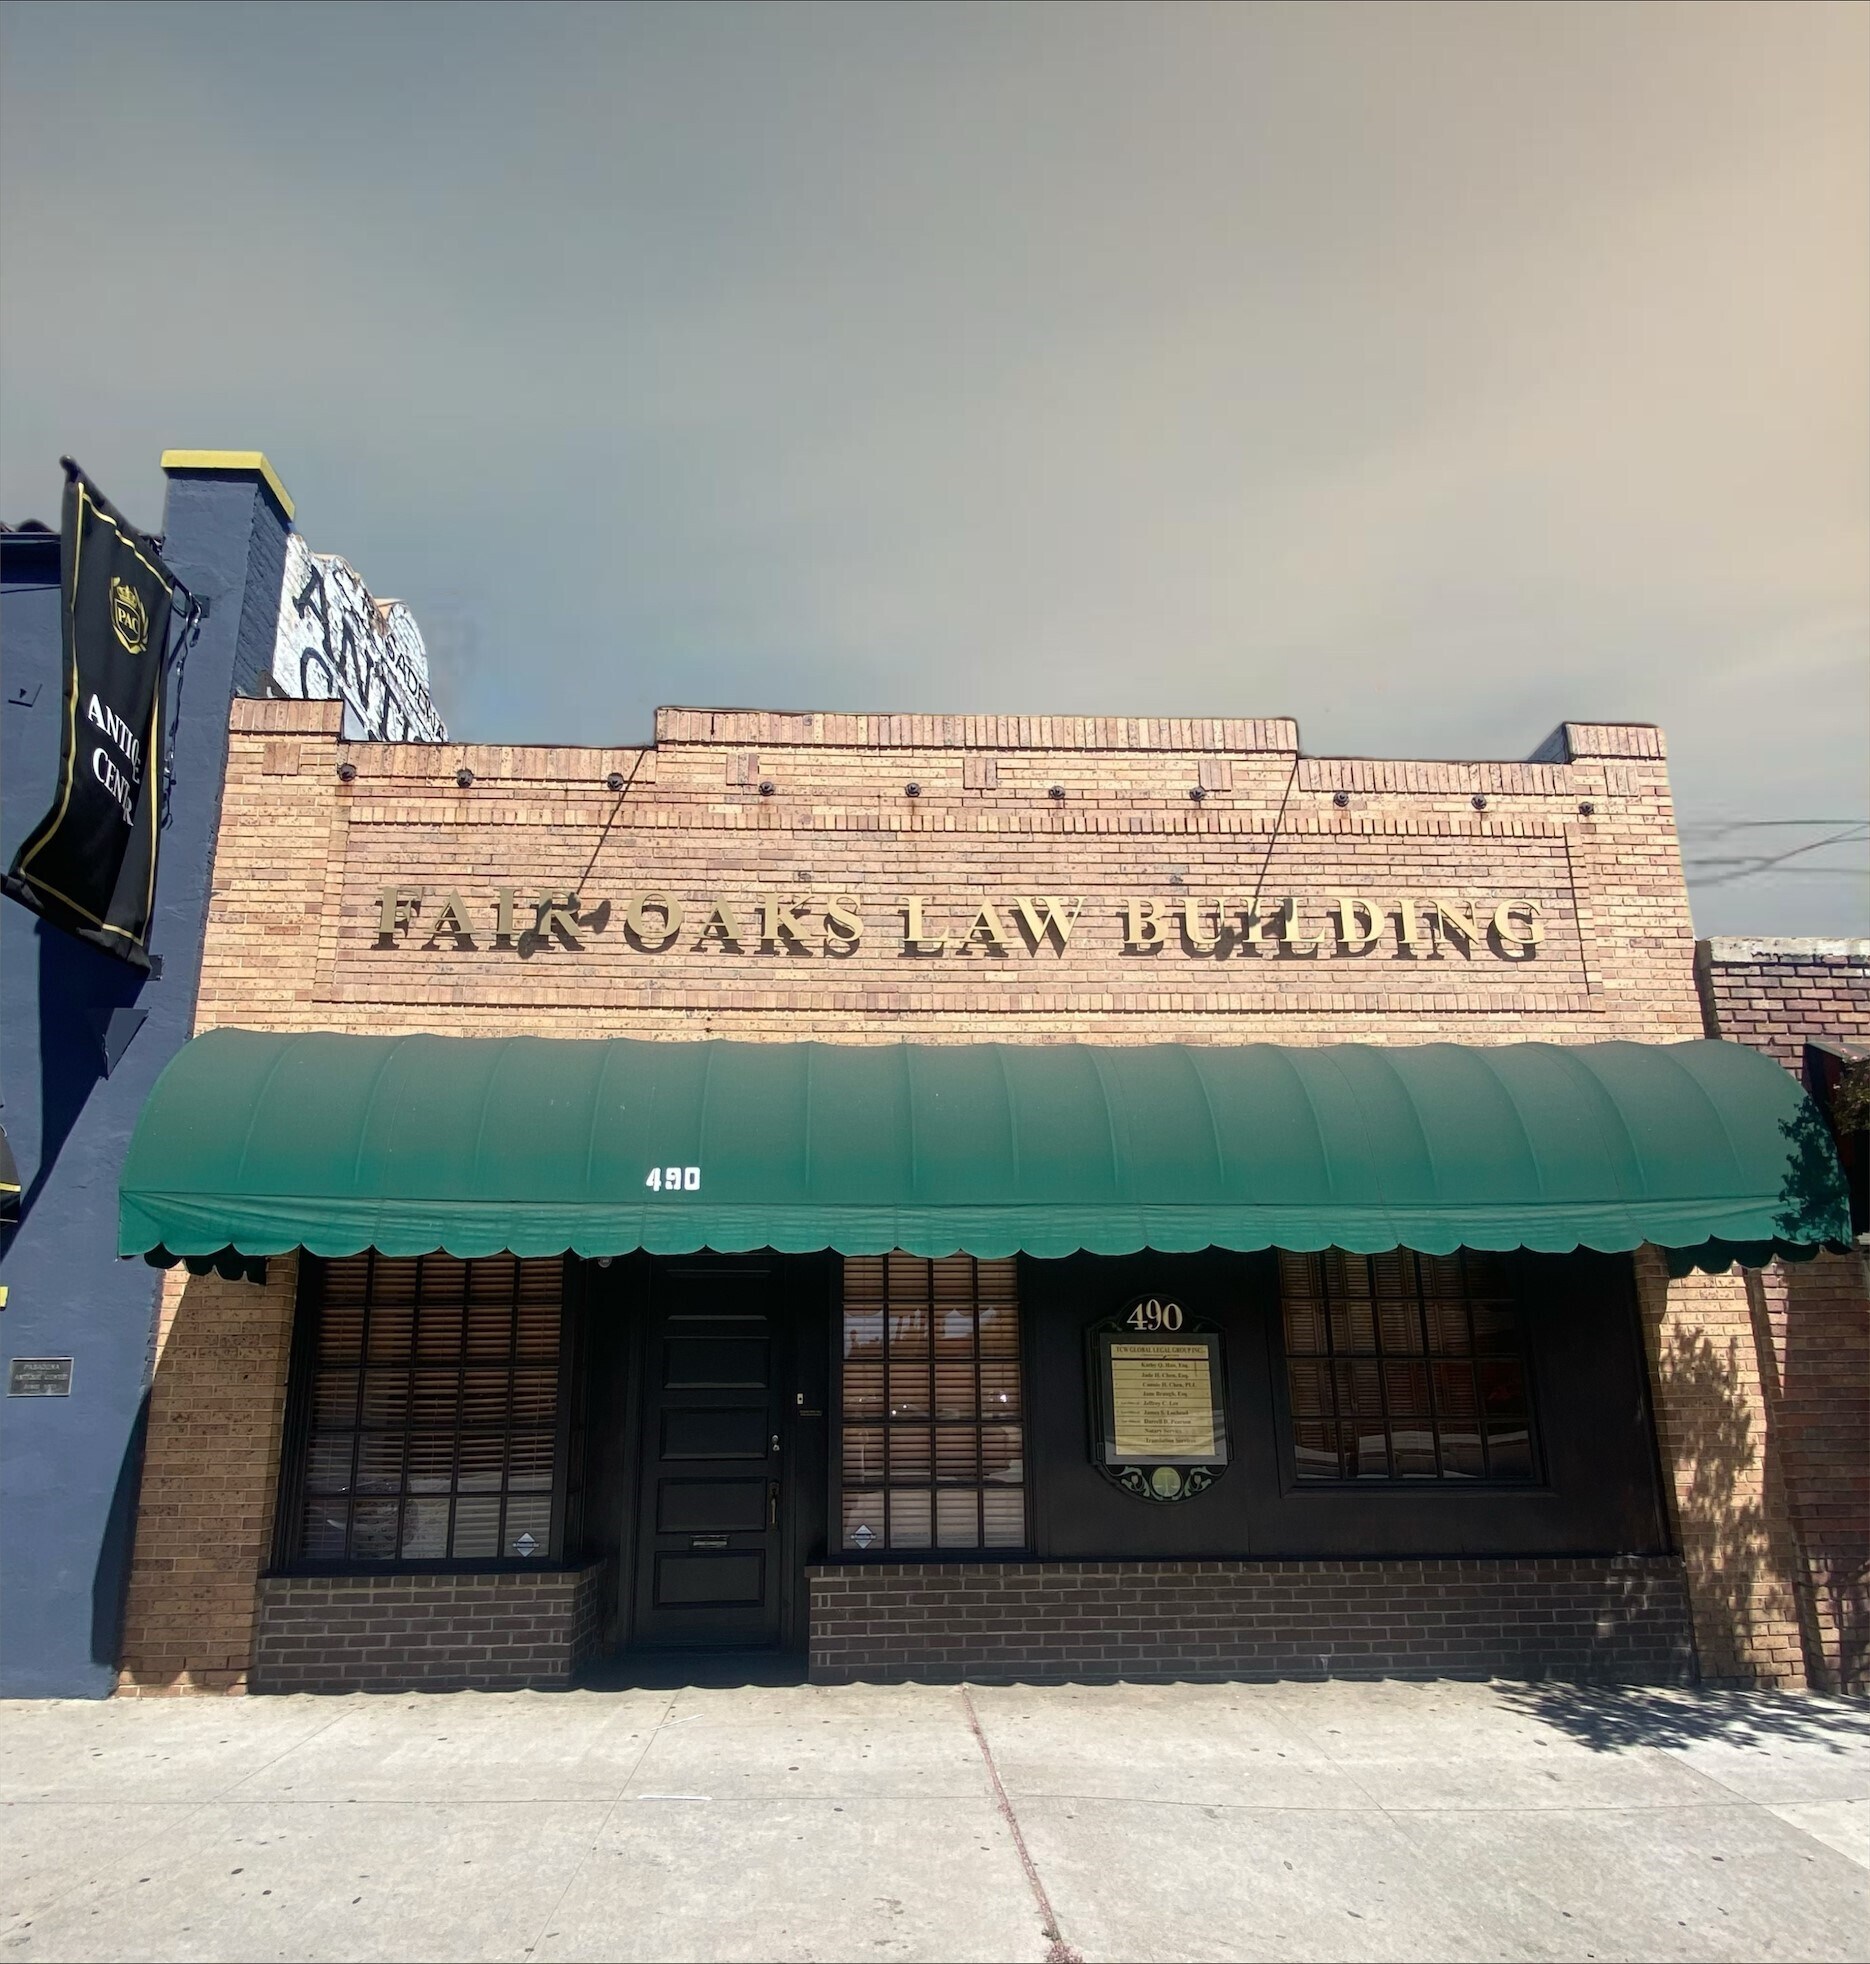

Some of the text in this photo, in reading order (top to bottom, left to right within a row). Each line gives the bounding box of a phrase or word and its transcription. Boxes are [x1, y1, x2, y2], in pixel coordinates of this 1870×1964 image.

[117, 607, 139, 634] PAC
[373, 886, 1547, 945] FAIR OAKS LAW BUILDING
[645, 1166, 701, 1192] 490
[1126, 1298, 1183, 1331] 490
